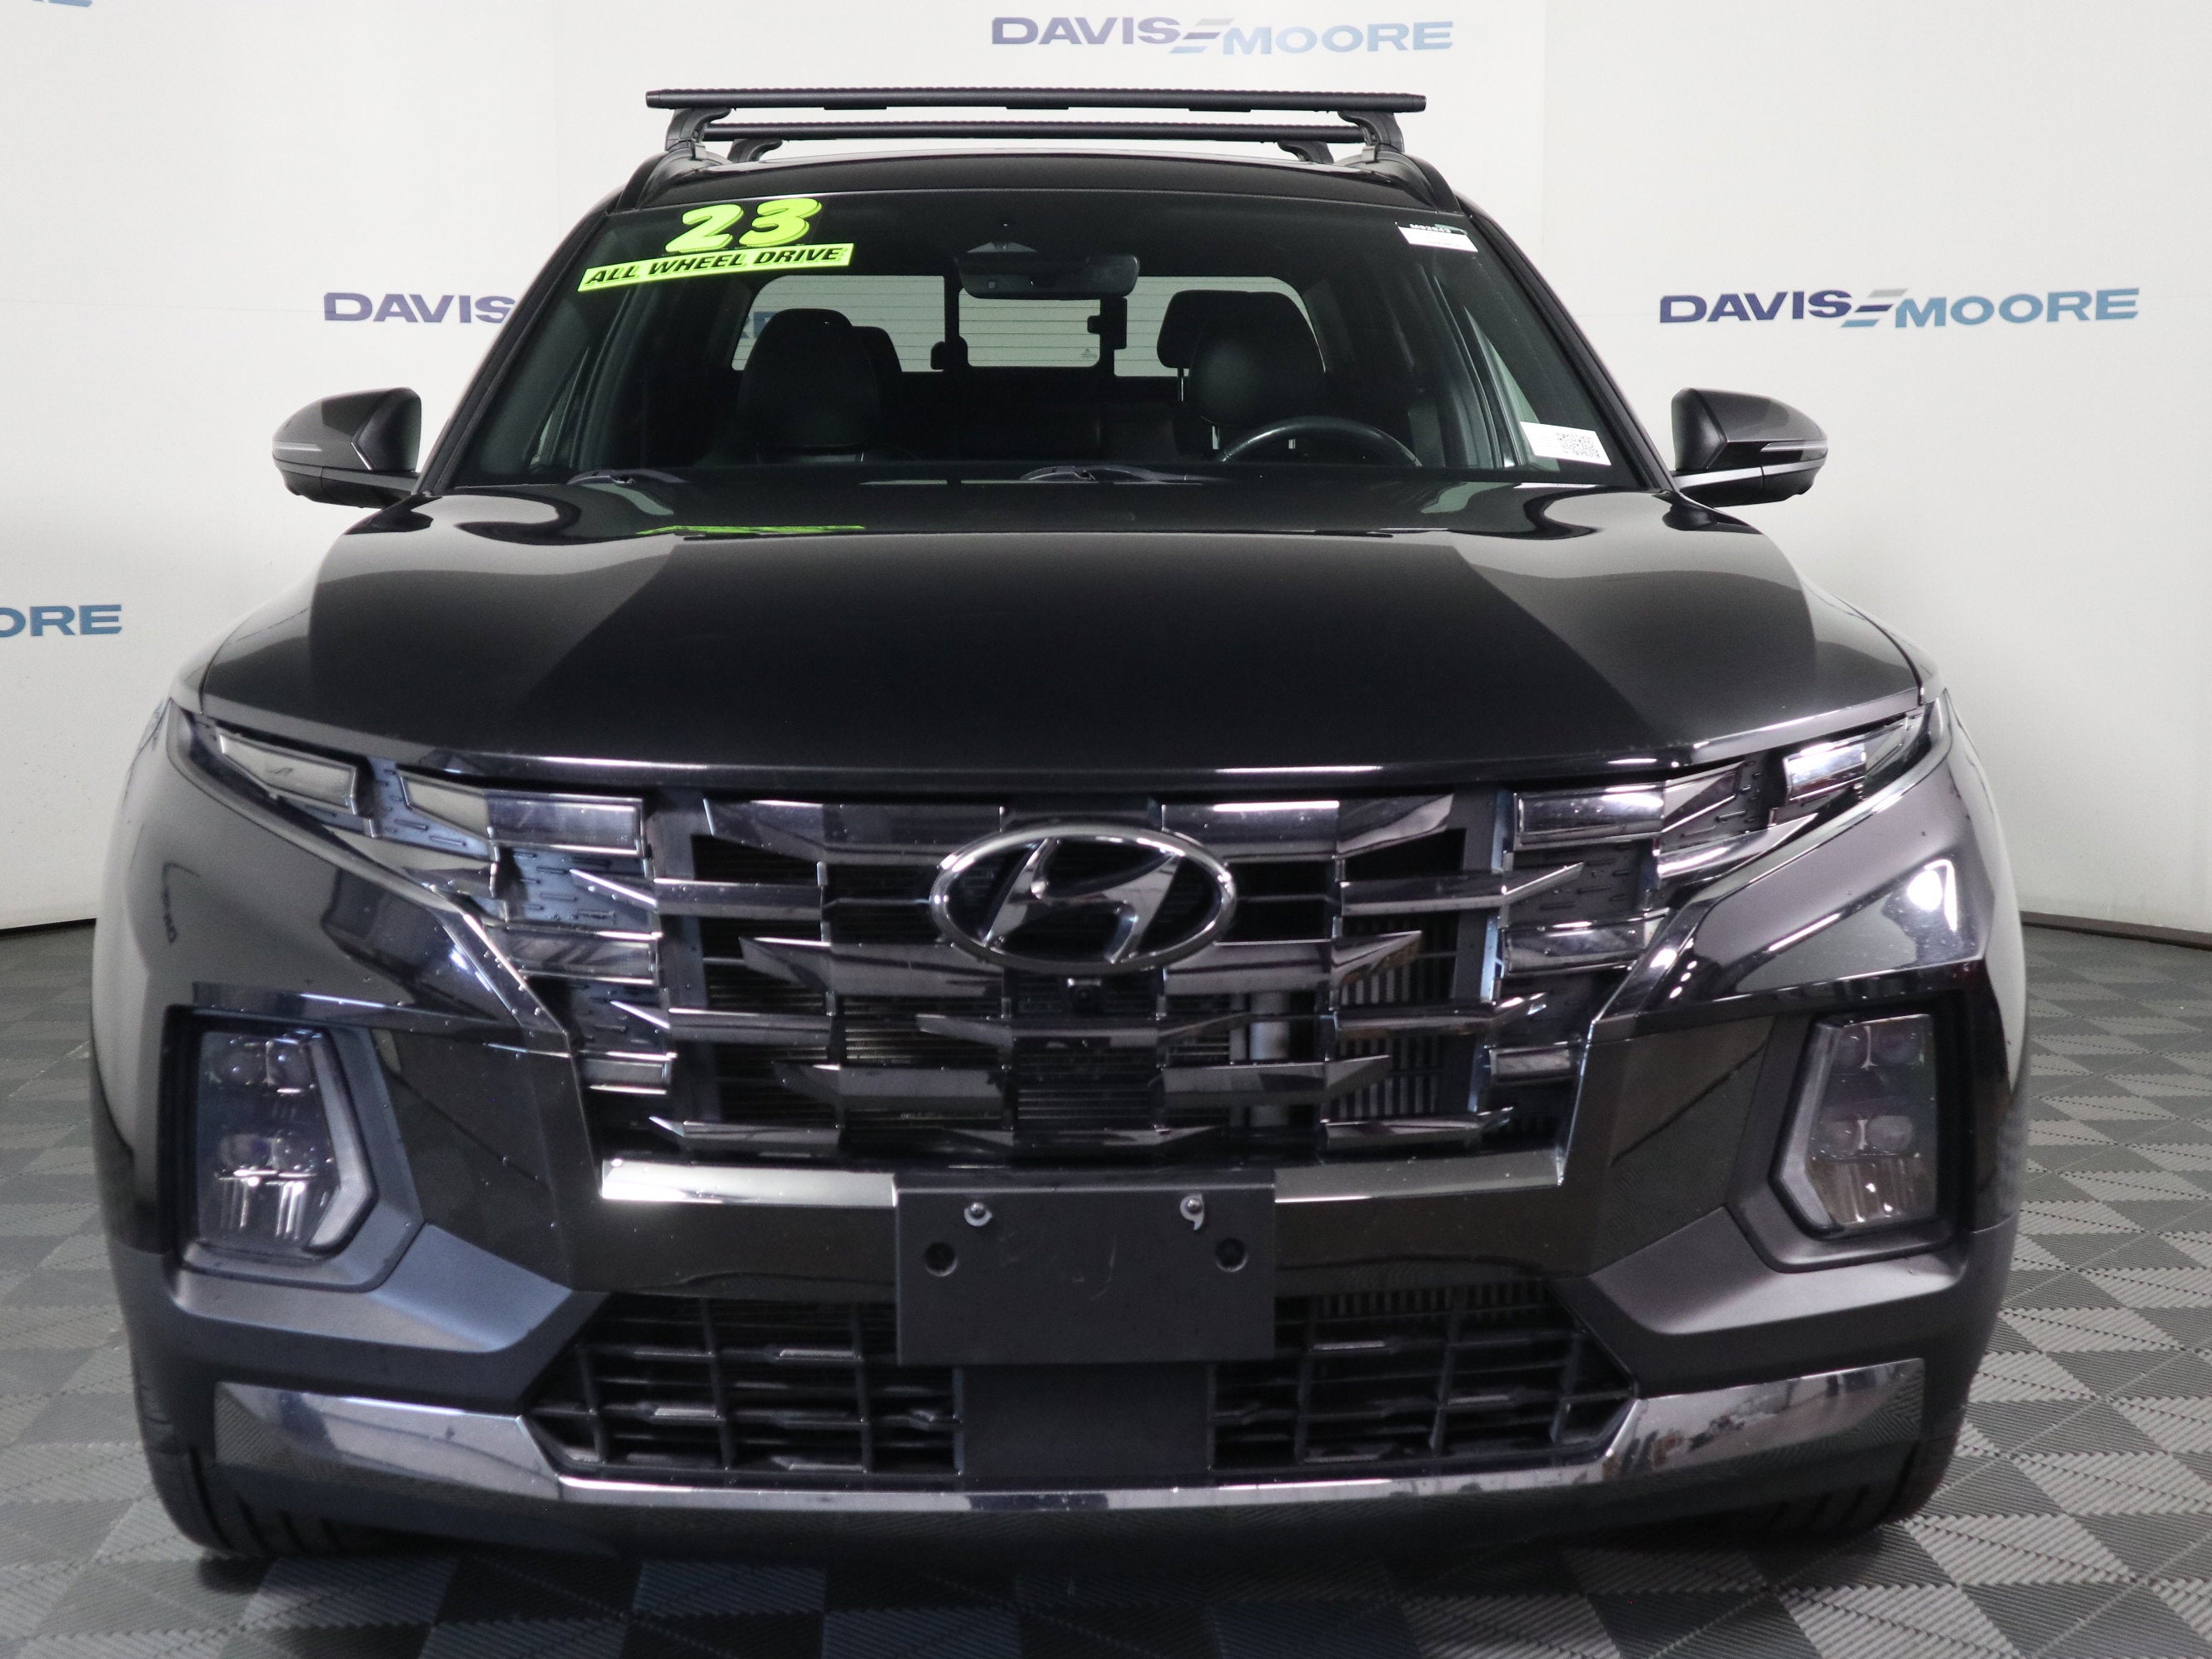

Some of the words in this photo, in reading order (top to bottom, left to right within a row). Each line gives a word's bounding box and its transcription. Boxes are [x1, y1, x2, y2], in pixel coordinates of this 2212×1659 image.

[991, 17, 1181, 45] DAVIS
[1223, 21, 1453, 55] MOORE
[665, 197, 822, 253] 23
[585, 264, 640, 285] ALL
[648, 252, 747, 276] WHEEL
[753, 247, 844, 264] DRIVE
[324, 292, 516, 323] DAVIS
[1660, 289, 1852, 323] DAVIS
[1895, 287, 2140, 328] MOORE
